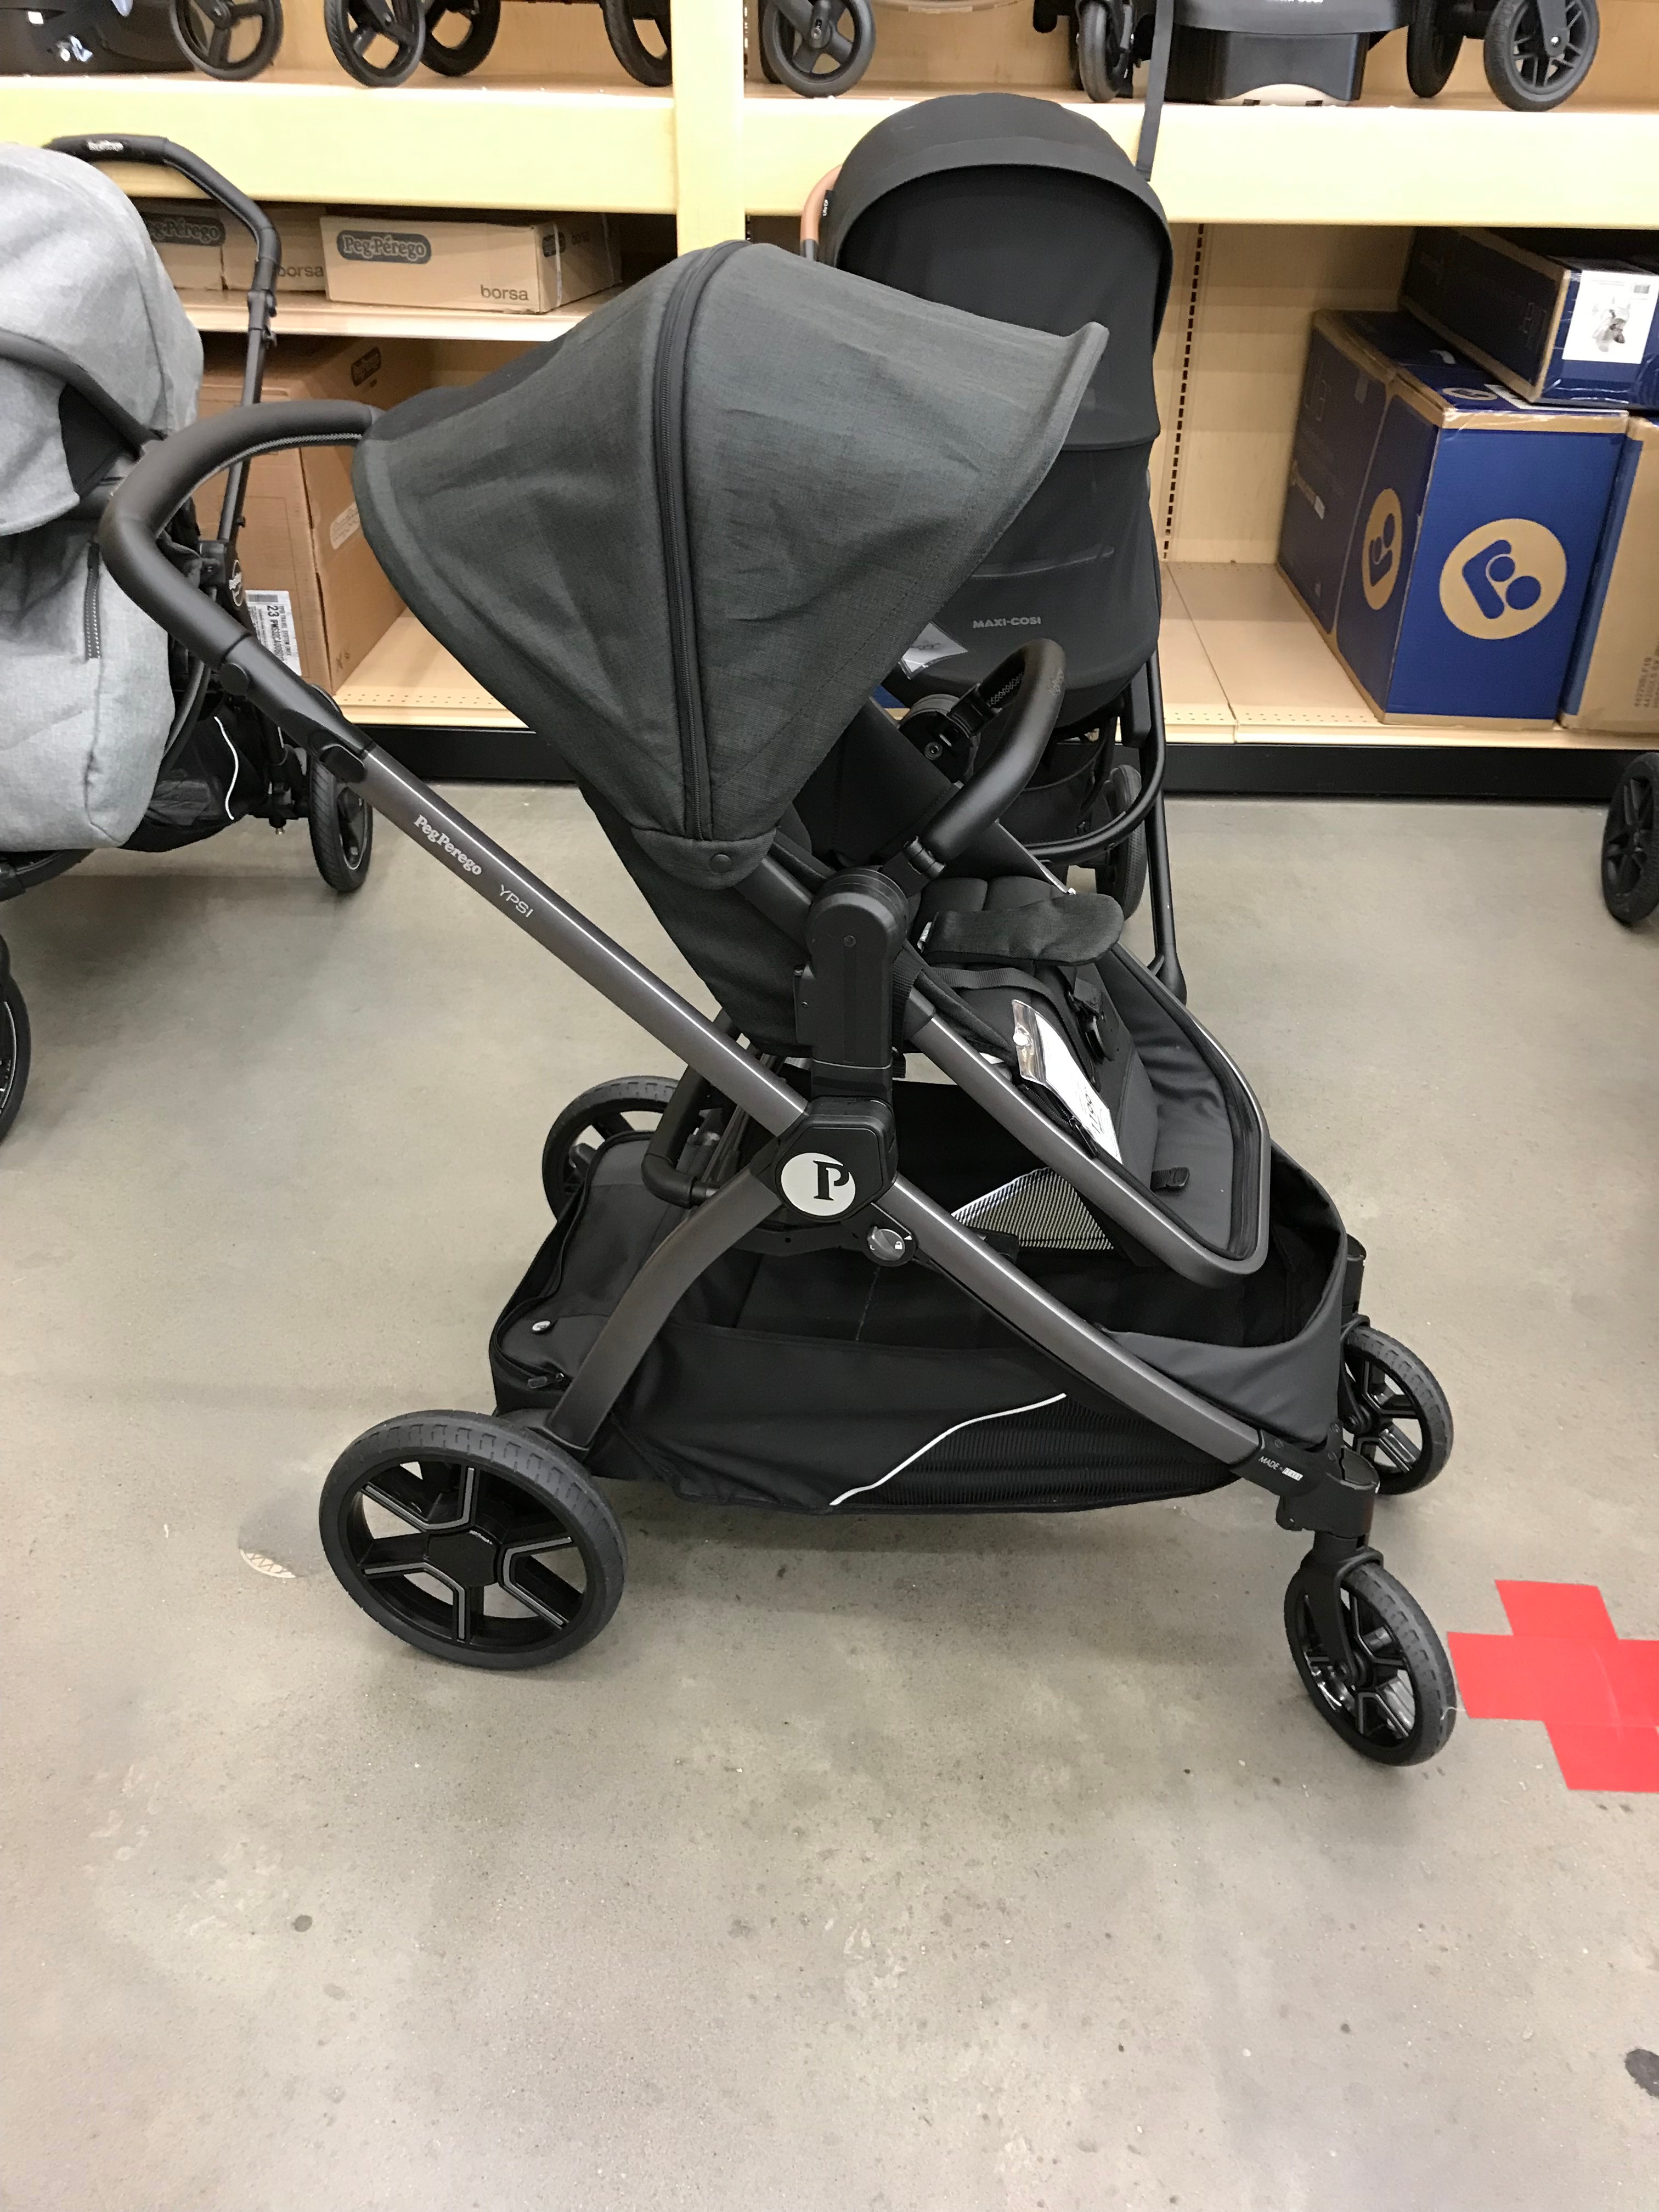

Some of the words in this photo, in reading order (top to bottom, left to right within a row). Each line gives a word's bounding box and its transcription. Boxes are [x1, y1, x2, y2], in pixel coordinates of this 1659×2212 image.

[480, 284, 529, 301] borsa
[267, 606, 279, 617] 23
[973, 616, 1041, 629] MAXI-COSI
[414, 814, 482, 876] PegPerego
[499, 884, 533, 918] YPSI
[812, 1160, 850, 1201] P
[1259, 1456, 1279, 1470] MADE
